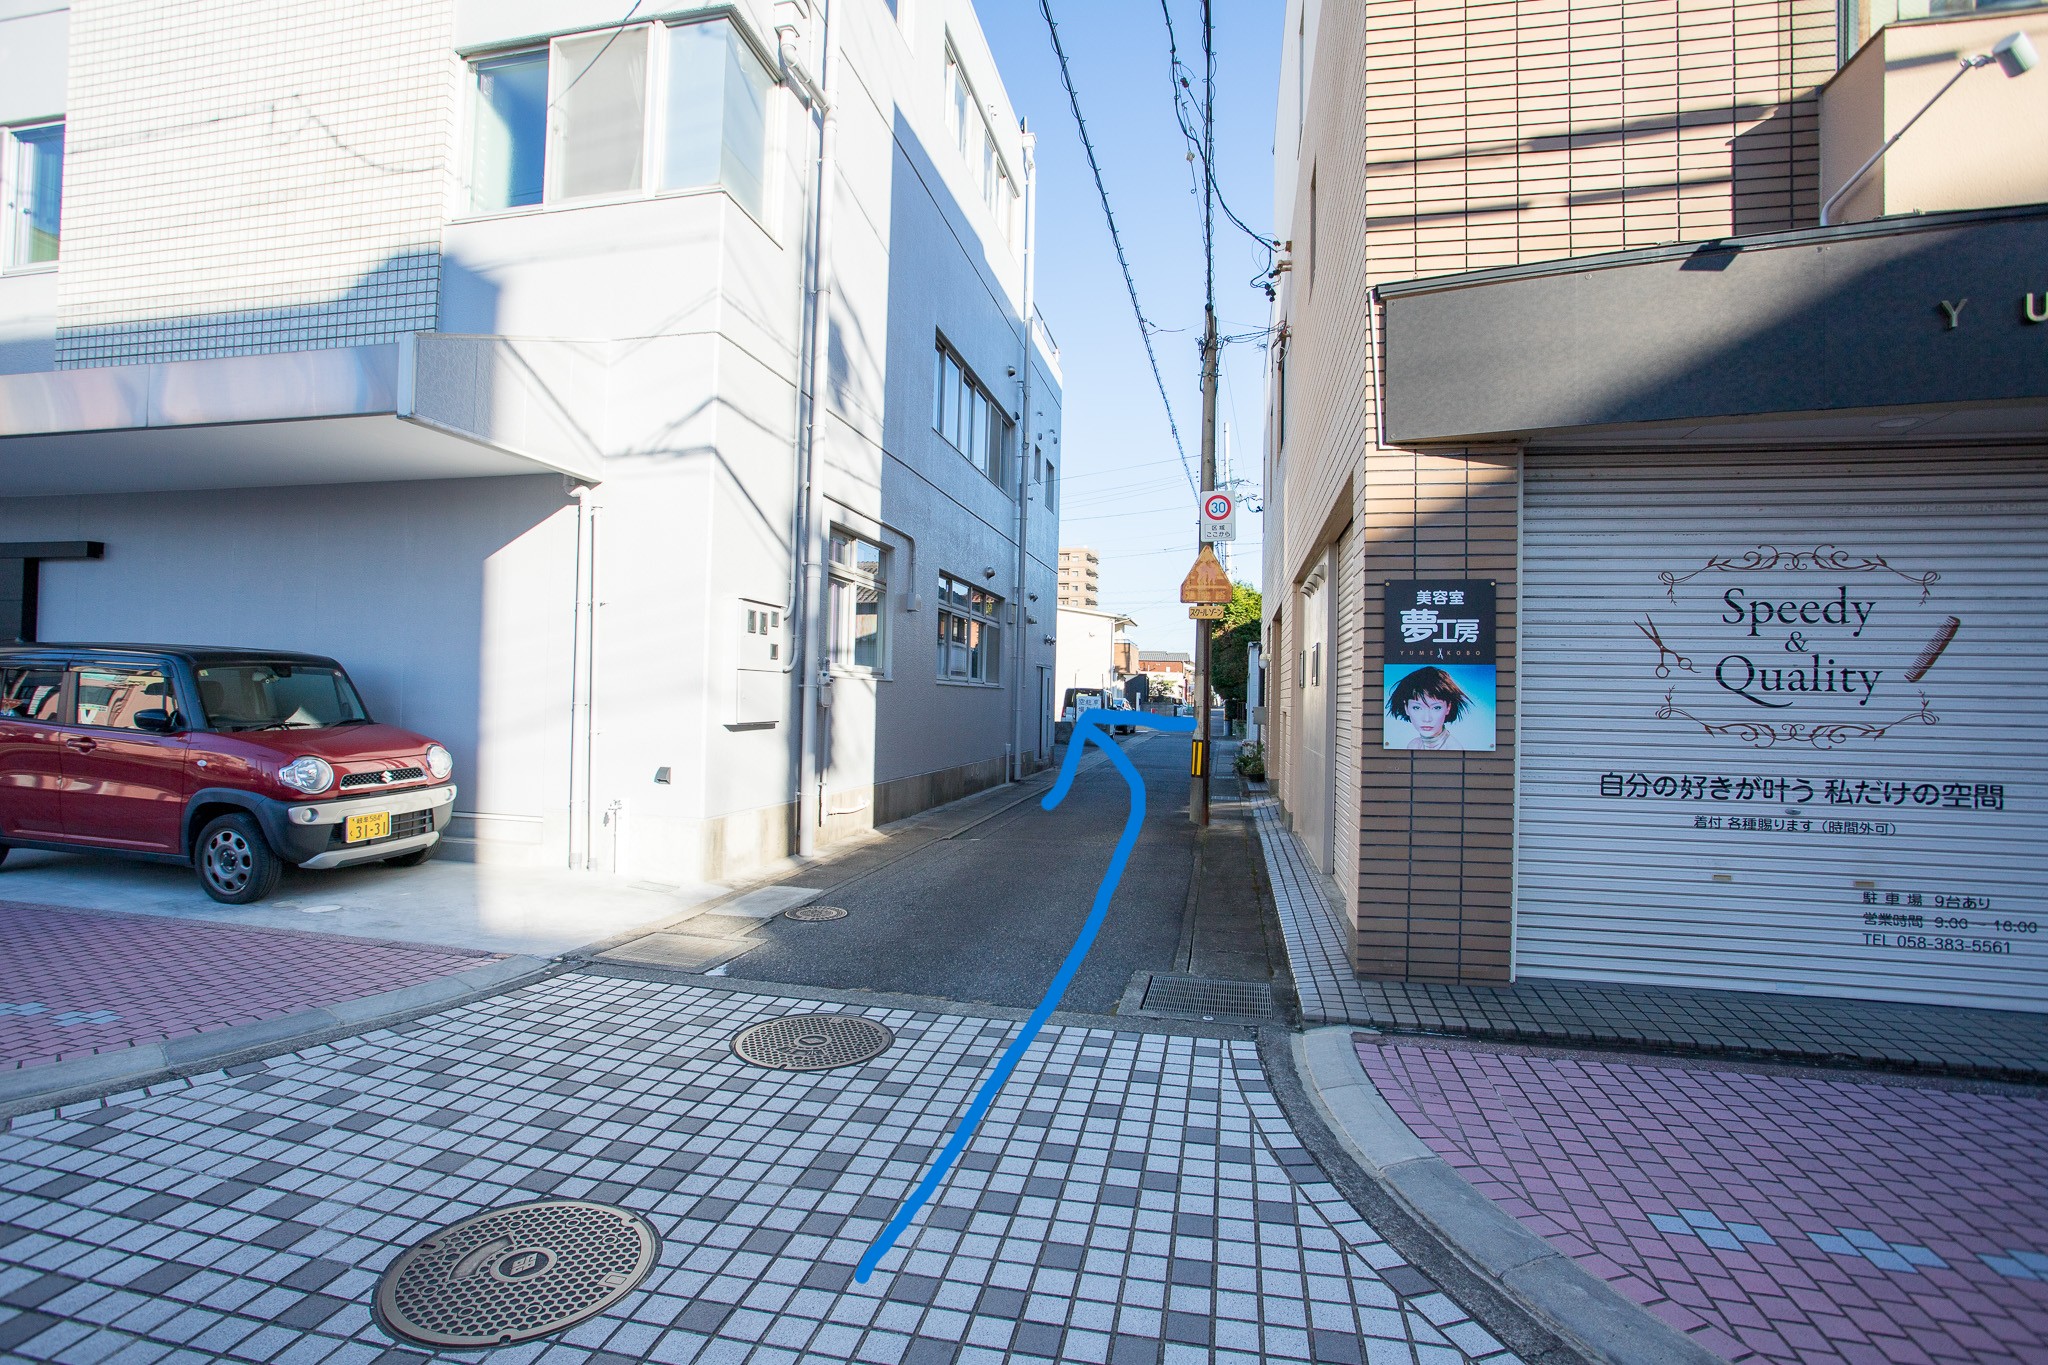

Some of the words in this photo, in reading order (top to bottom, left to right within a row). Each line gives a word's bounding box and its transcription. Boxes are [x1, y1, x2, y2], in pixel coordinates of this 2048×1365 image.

[1211, 501, 1226, 514] 30
[1416, 589, 1465, 605] 美容室
[1190, 608, 1223, 617] スクールゾーン
[1722, 586, 1876, 637] Speedy
[1400, 608, 1480, 643] 夢工房
[1784, 631, 1810, 653] &
[1715, 654, 1884, 708] Quality
[1600, 771, 1814, 803] 自分の好きが叶う
[1824, 779, 2004, 810] 私だけの空間
[356, 821, 386, 839] 31-31
[1693, 815, 1723, 830] 着付
[1862, 891, 1923, 907] 駐車場
[1934, 894, 1990, 910] 9台あり
[1862, 911, 1923, 928] 営業時間
[1934, 916, 1968, 930] 9:00
[1862, 933, 1891, 947] TEL
[1896, 935, 2010, 954] 058-383-5561
